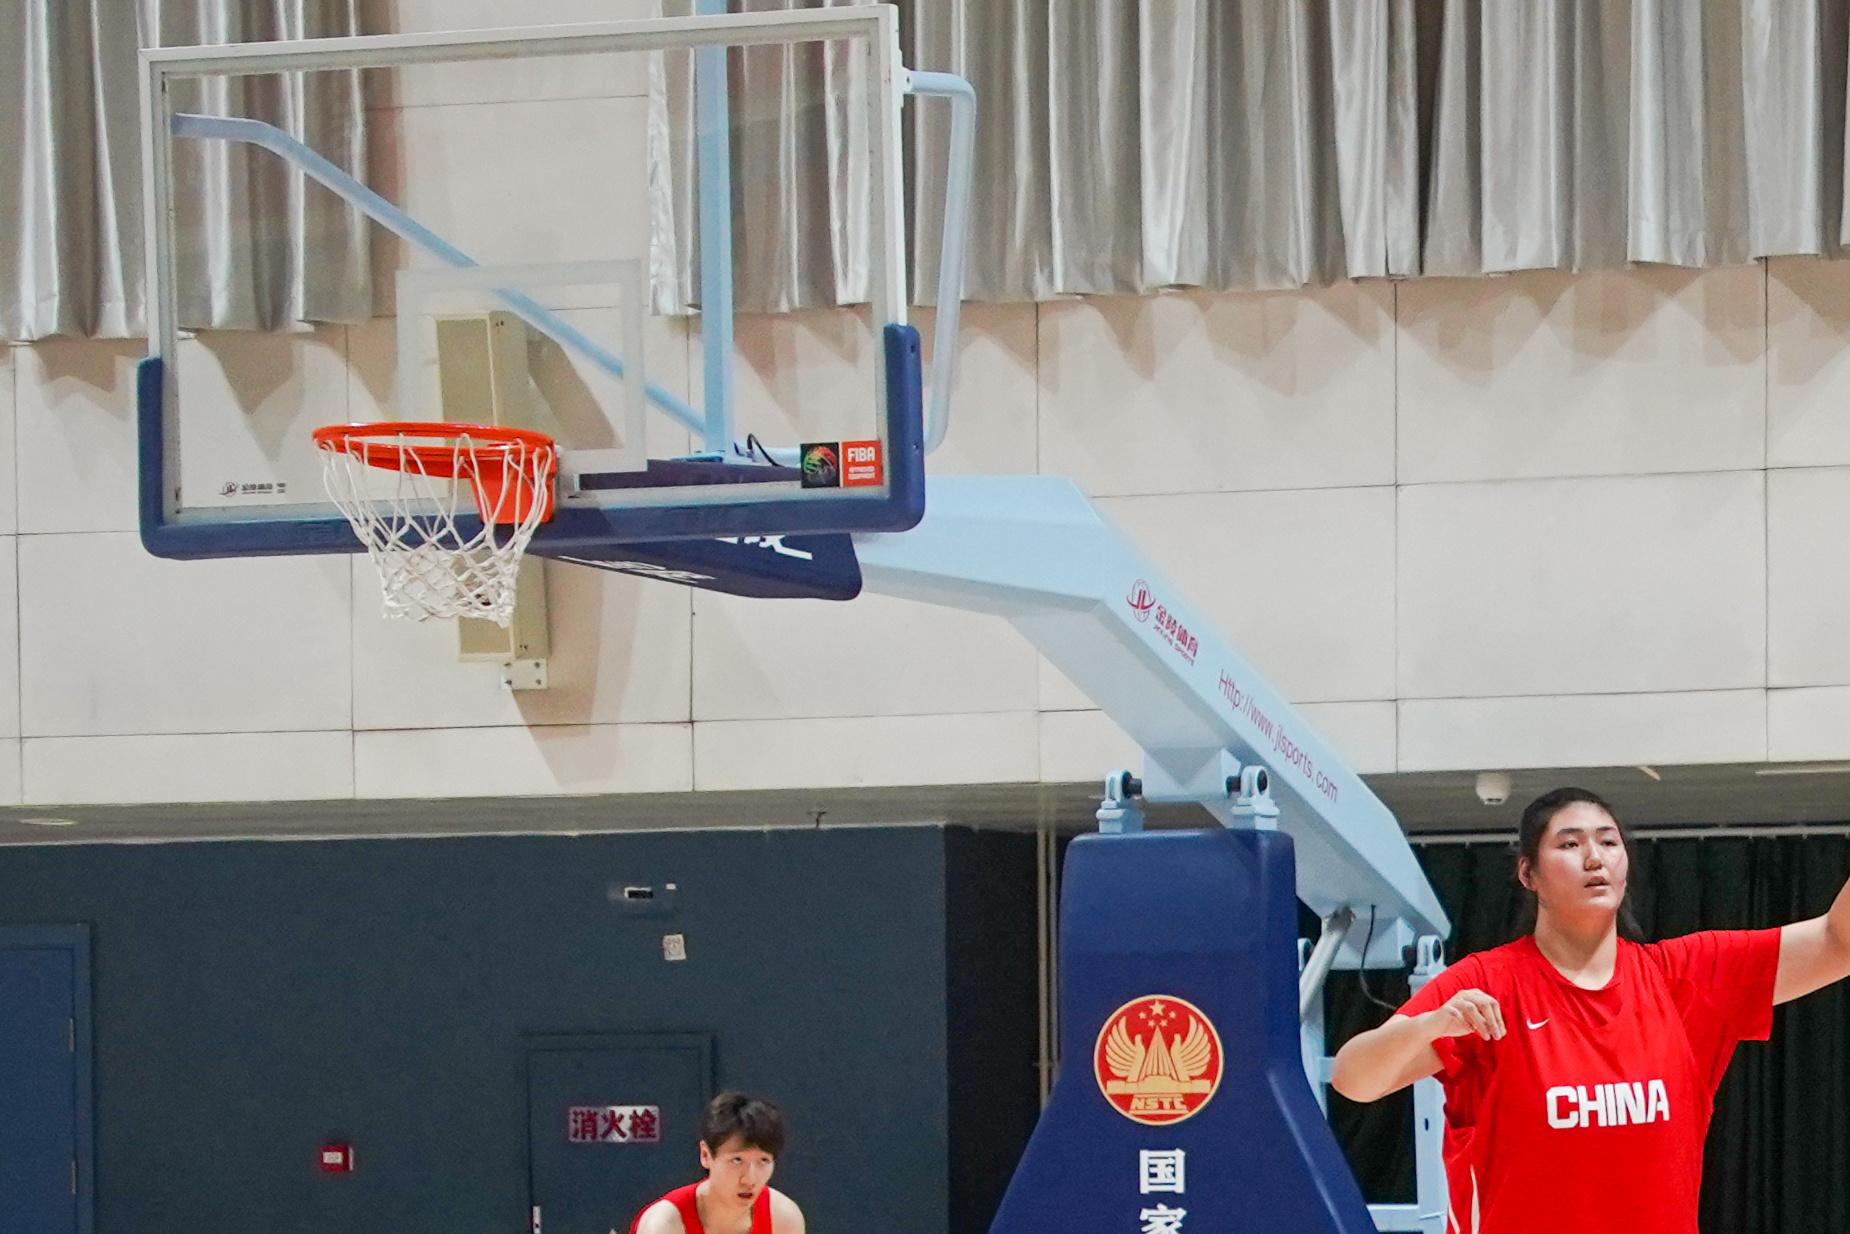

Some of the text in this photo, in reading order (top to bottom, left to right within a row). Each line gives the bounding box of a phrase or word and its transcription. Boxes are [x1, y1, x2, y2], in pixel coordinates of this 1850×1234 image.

[847, 446, 876, 463] FIBA
[1546, 1079, 1670, 1129] CHINA
[572, 1108, 657, 1140] 消火栓
